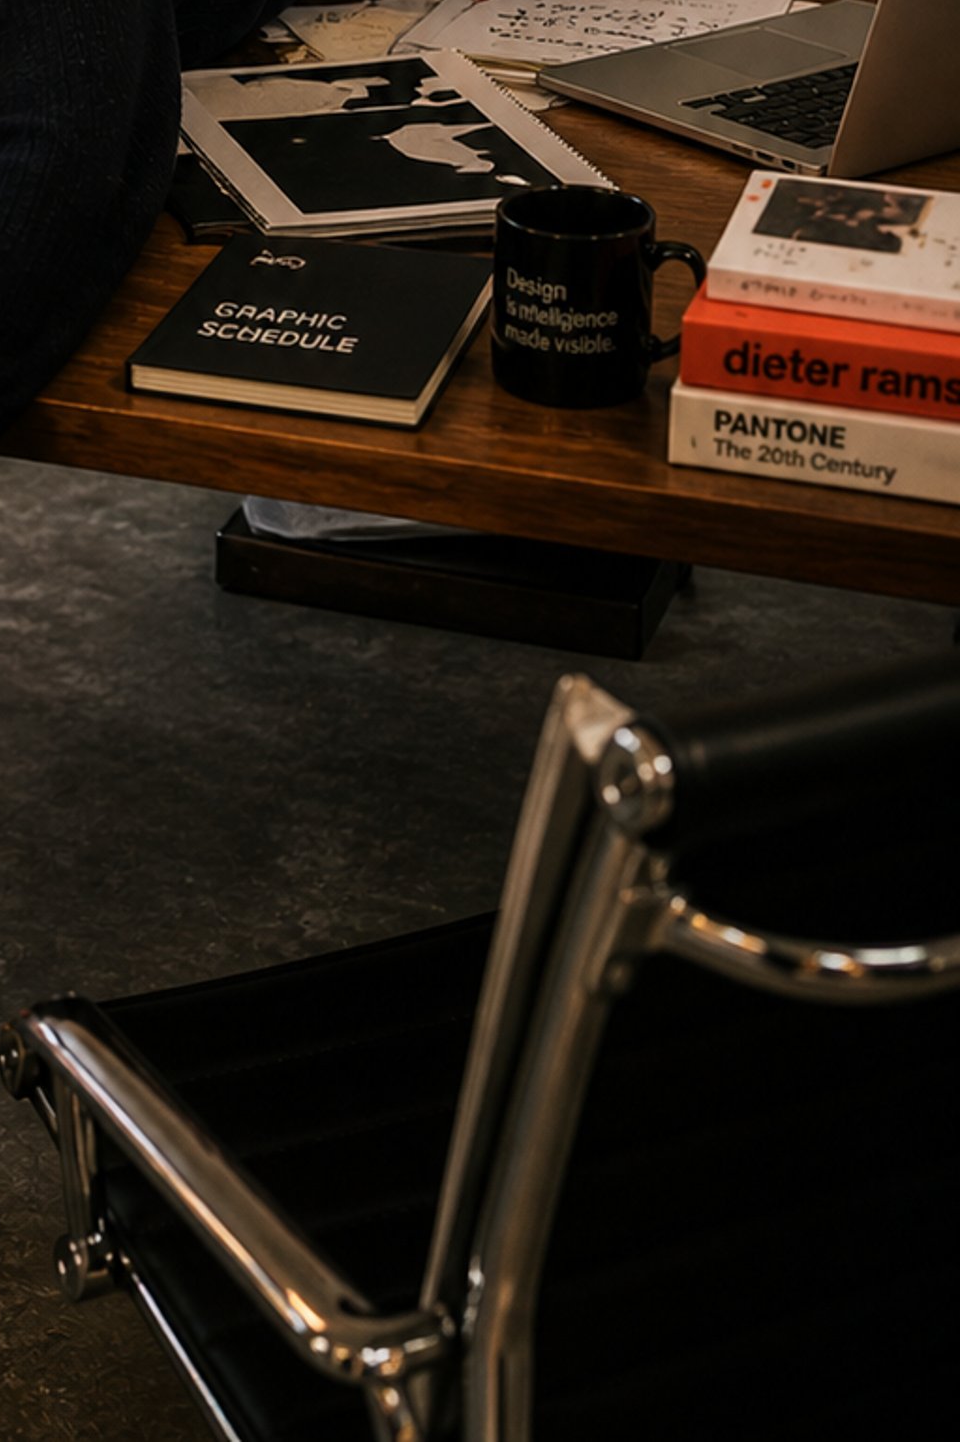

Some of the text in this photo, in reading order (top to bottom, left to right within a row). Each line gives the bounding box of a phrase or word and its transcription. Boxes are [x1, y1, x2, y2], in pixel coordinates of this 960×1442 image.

[506, 266, 568, 304] Design
[214, 301, 348, 330] GRAPHIC
[196, 321, 359, 353] SCHEDULE
[505, 324, 550, 351] made
[723, 341, 960, 406] dieter rams
[714, 410, 847, 449] PANTONE
[713, 437, 897, 486] The 20th Century
